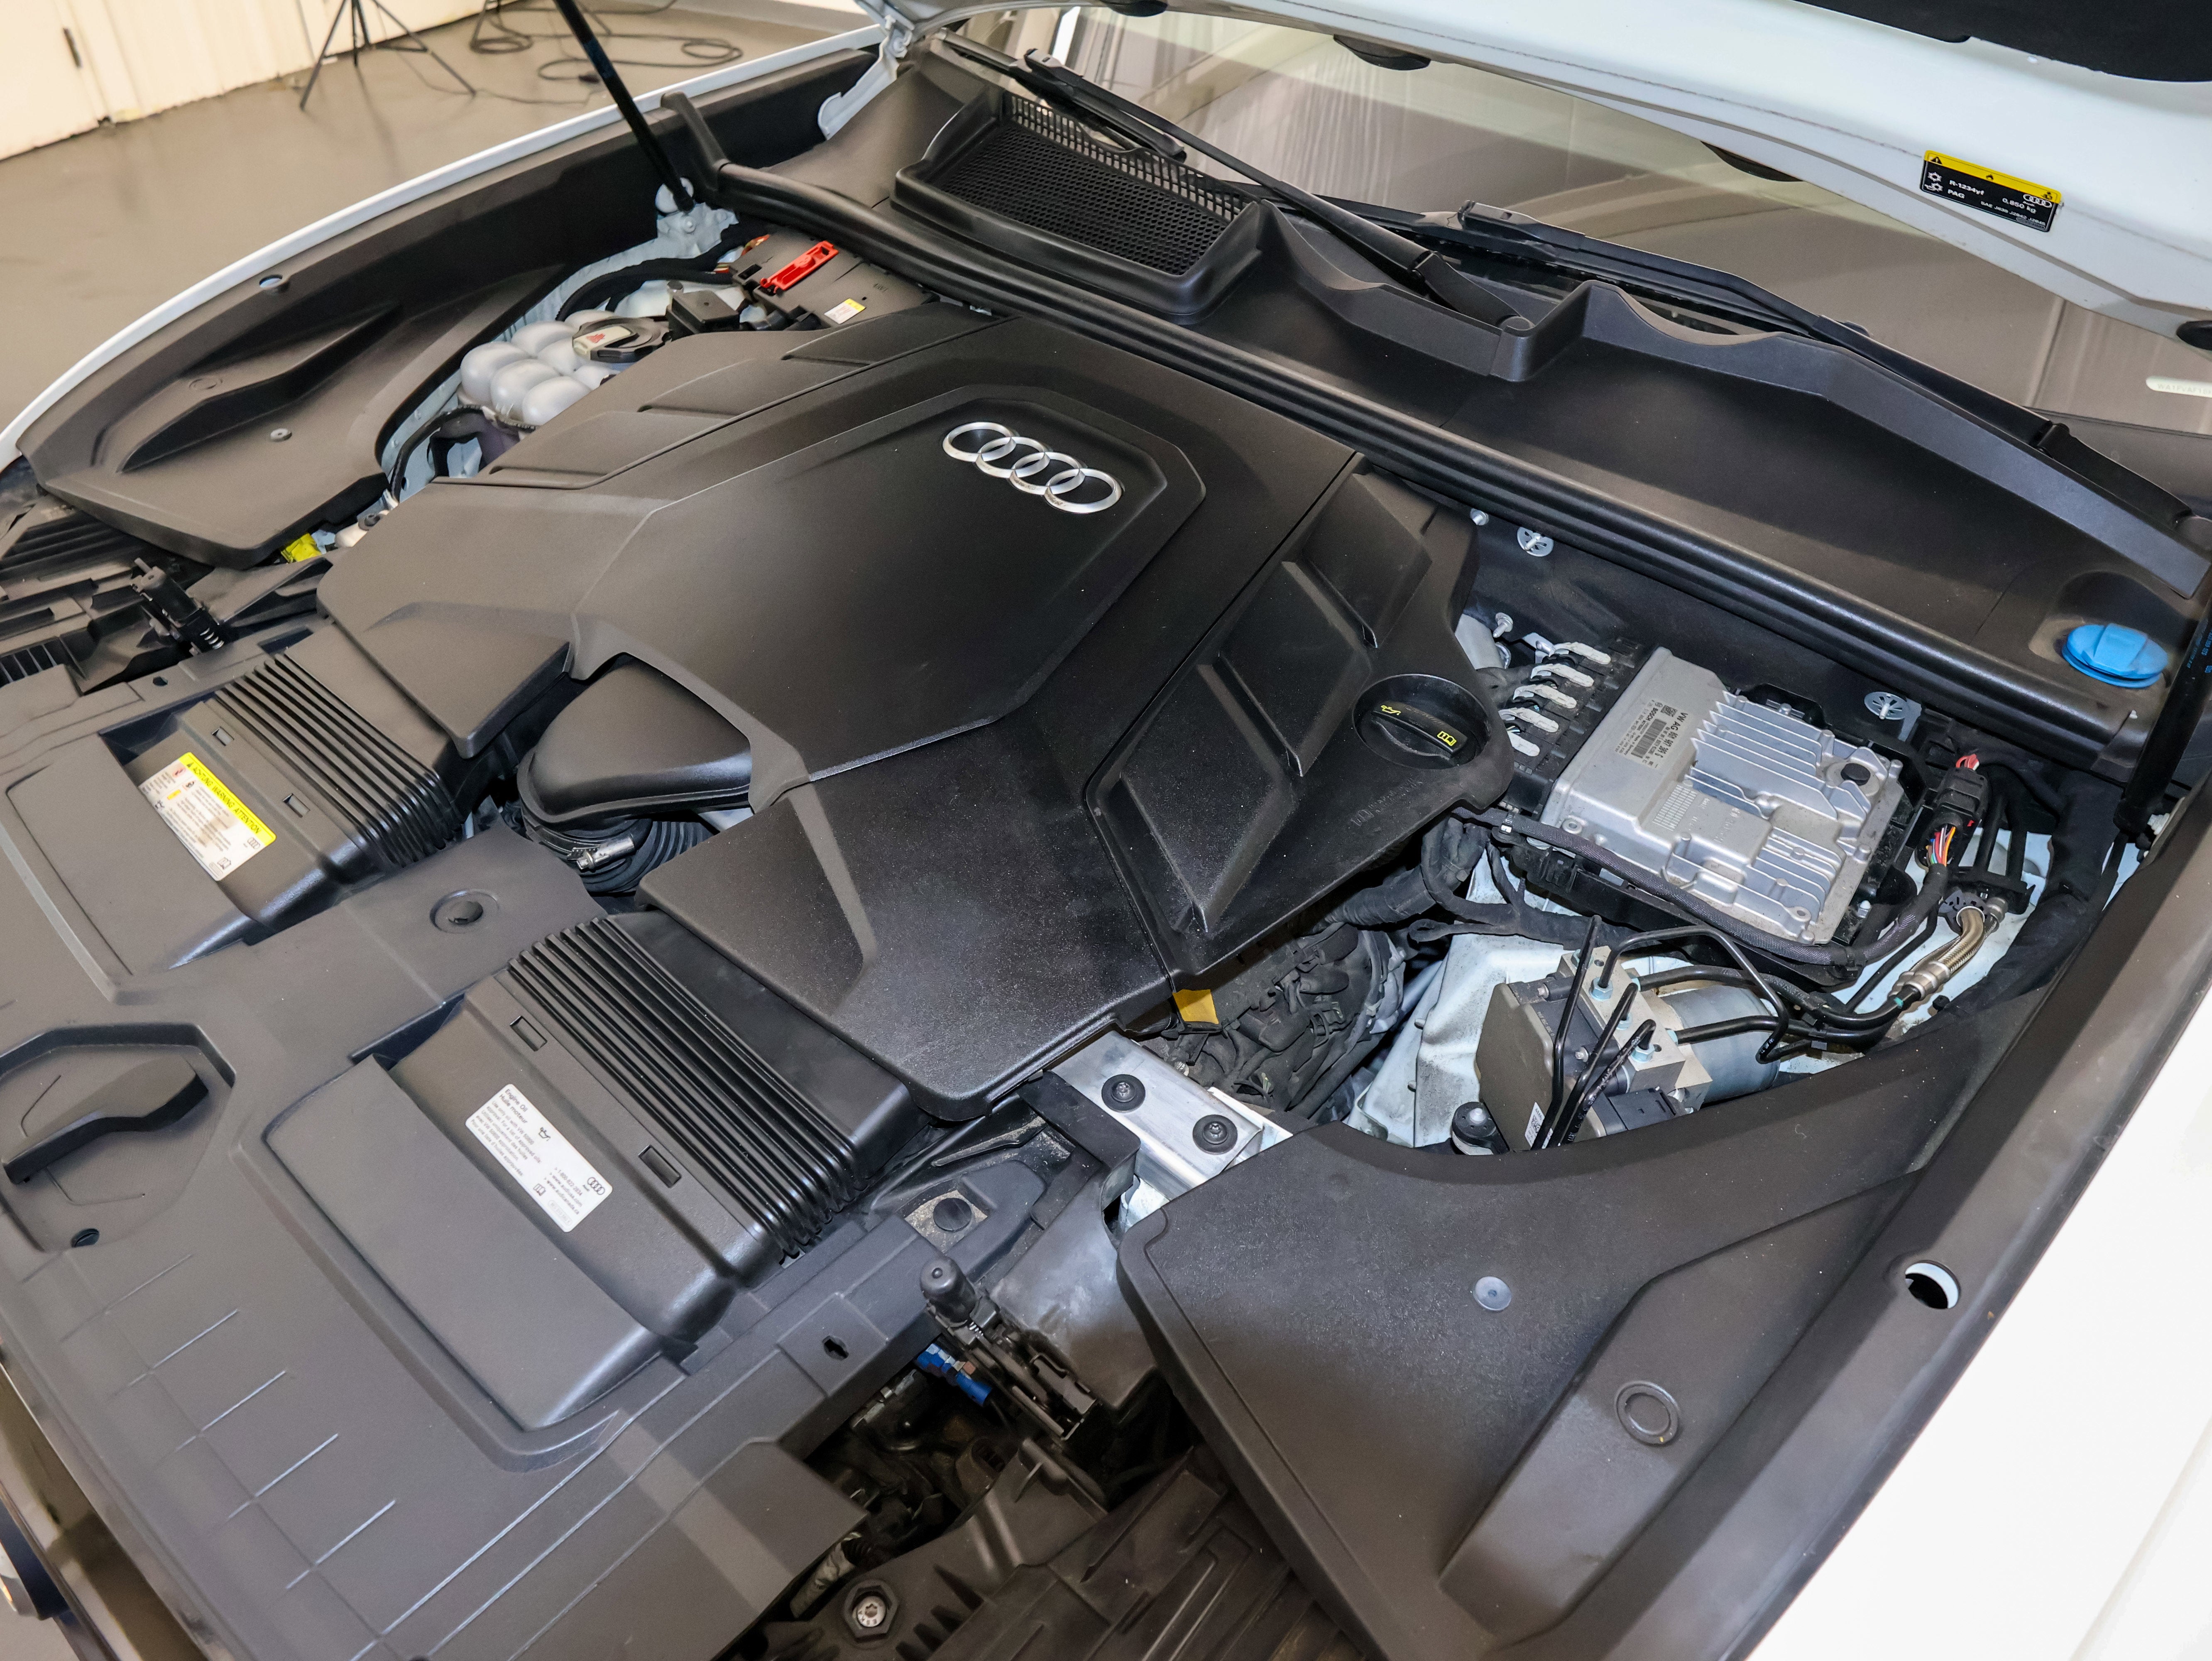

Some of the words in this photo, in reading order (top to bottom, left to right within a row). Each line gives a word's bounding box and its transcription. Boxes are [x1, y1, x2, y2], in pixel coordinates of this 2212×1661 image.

[1947, 189, 1965, 199] PAG
[1949, 179, 1984, 196] R-1234yf
[2002, 198, 2025, 209] 0.850
[2026, 205, 2037, 214] kg
[1645, 707, 1659, 721] BOSCH
[1676, 711, 1688, 722] VW
[1670, 721, 1681, 731] AG
[191, 767, 213, 786] ACHTUNG
[211, 786, 235, 808] WARNING
[232, 807, 262, 834] ATTENTION
[504, 1088, 521, 1106] Engine
[519, 1103, 528, 1112] Oil
[497, 1107, 507, 1116] only
[509, 1119, 519, 1128] with
[498, 1094, 512, 1107] Huile
[509, 1105, 528, 1124] moteur
[470, 1119, 480, 1129] Pour
[475, 1115, 484, 1124] avec
[491, 1122, 512, 1143] uniquement
[517, 1139, 535, 1157] approved
[546, 1179, 580, 1215] www.audicanada.ca
[551, 1174, 583, 1207] www.audiusa.com
